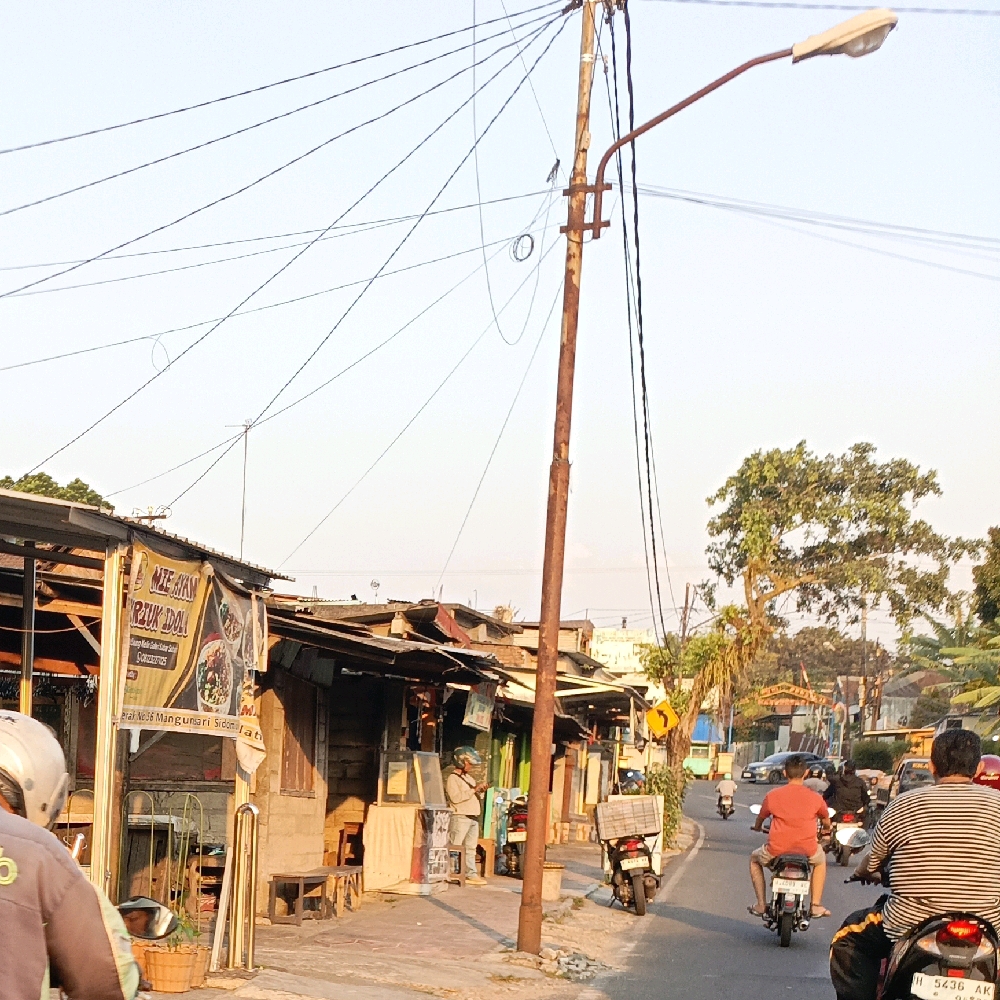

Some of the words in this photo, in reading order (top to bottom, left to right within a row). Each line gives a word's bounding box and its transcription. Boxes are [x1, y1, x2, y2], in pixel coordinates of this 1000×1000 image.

[150, 565, 175, 595] MIE
[131, 599, 164, 632] RIUK
[156, 711, 211, 727] Mangunsari
[915, 976, 923, 987] H
[934, 978, 965, 992] 5436
[975, 984, 991, 997] AK
